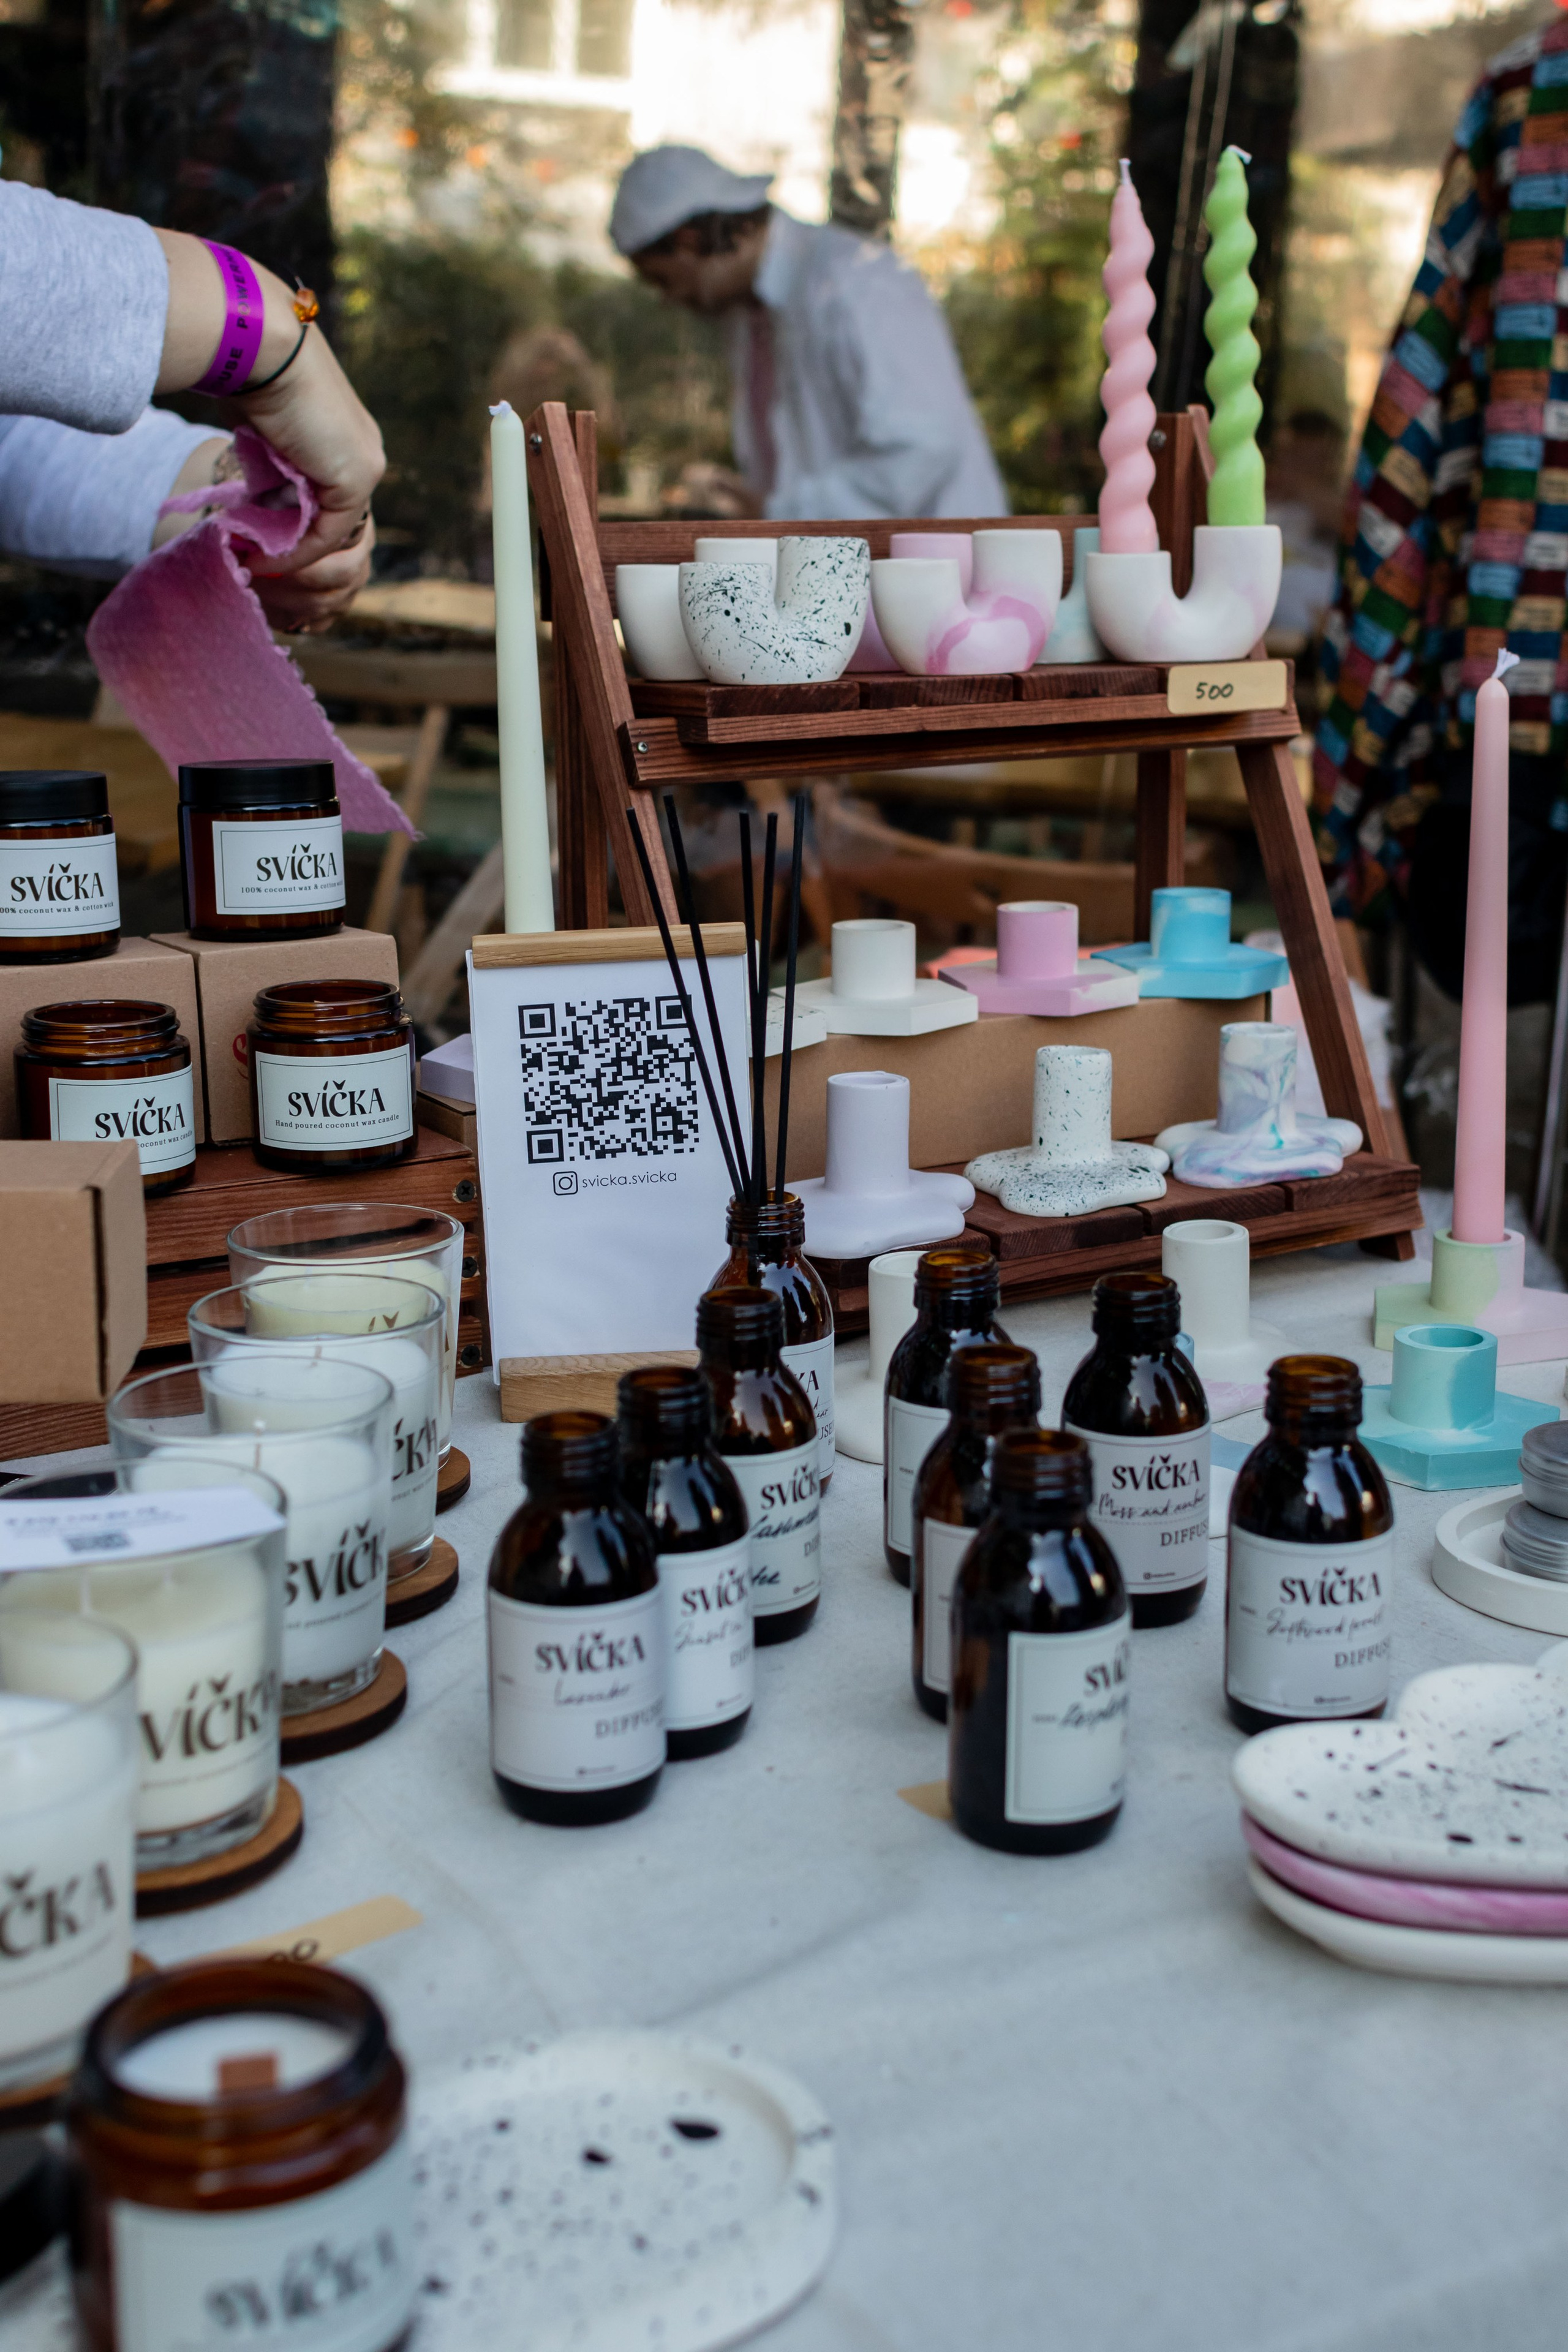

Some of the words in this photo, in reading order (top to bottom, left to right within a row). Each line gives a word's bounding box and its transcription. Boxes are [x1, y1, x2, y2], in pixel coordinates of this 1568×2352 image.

[1196, 682, 1234, 699] 500
[256, 843, 337, 881] SVÍČKA
[10, 862, 104, 902] SVÍČKA
[95, 1096, 186, 1139] SVÍČKA
[288, 1080, 386, 1117] SVÍČKA
[276, 1120, 293, 1128] Hand
[378, 1114, 399, 1124] candle
[582, 1170, 677, 1188] svicka.svicka
[761, 1463, 818, 1511] SVÍČK
[1112, 1453, 1200, 1490] SVÍČKA
[1140, 1498, 1171, 1517] and
[681, 1567, 747, 1616] SVÍČK
[1280, 1566, 1381, 1606] SVÍČKA
[535, 1630, 646, 1673] SVÍČKA
[0, 1861, 116, 1959] ČKA
